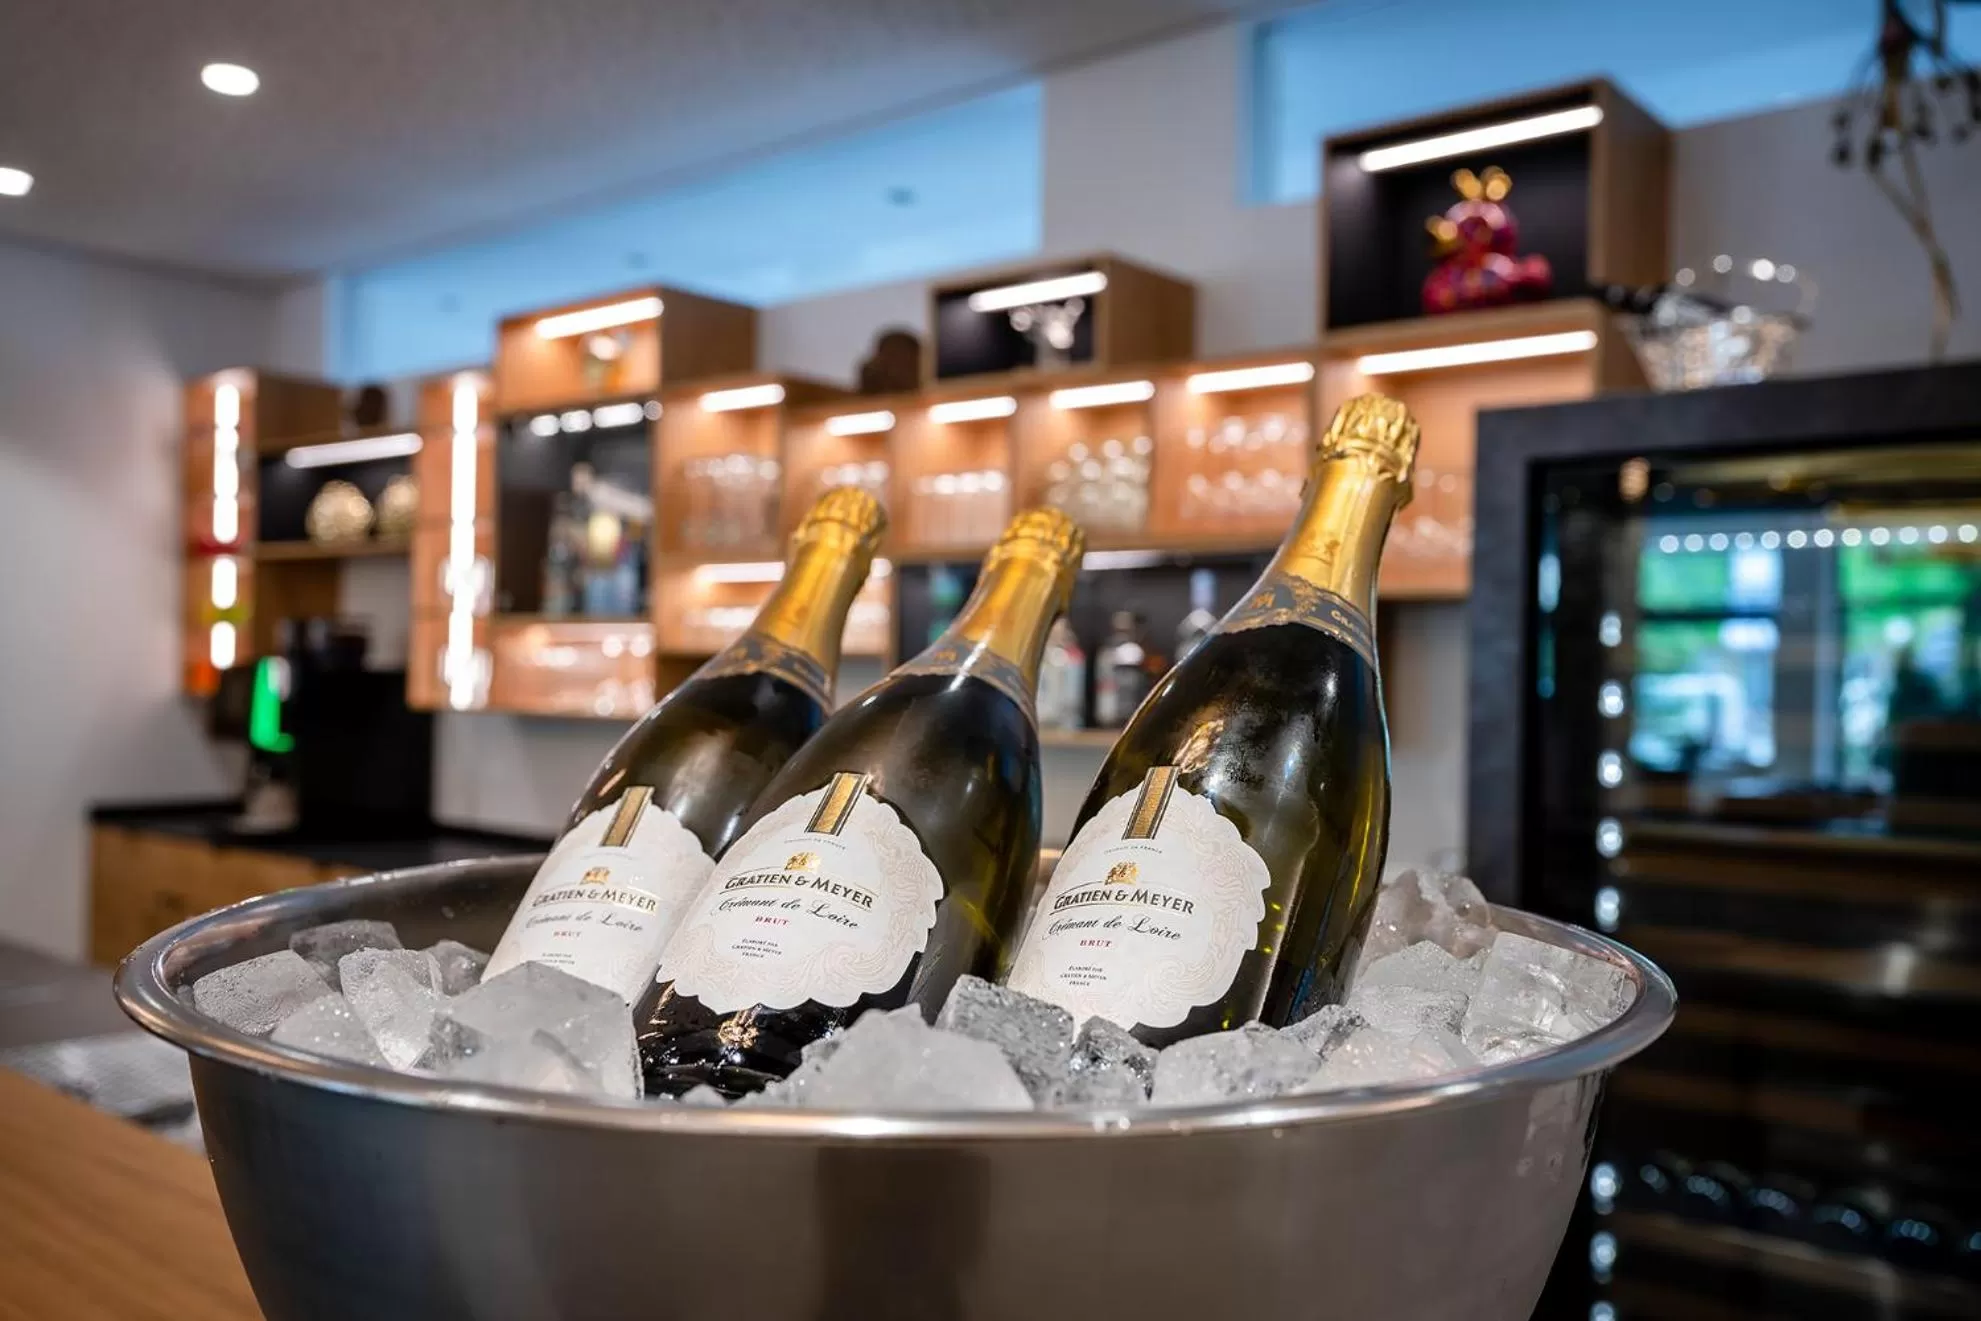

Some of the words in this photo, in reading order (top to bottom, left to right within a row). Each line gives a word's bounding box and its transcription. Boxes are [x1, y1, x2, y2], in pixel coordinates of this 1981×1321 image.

[587, 889, 601, 899] &
[601, 889, 656, 911] MEYER
[725, 874, 792, 890] GRATIEN
[794, 875, 809, 887] &
[810, 877, 873, 909] MEYER
[1054, 889, 1112, 910] GRATIEN
[1114, 889, 1129, 902] &
[1130, 888, 1194, 915] MEYER
[600, 912, 643, 932] Loire
[755, 916, 789, 926] BRUT
[781, 898, 801, 910] de
[806, 900, 859, 929] Loire
[1103, 915, 1122, 929] de
[1127, 914, 1180, 940] Loire
[1080, 939, 1112, 948] BRUT
